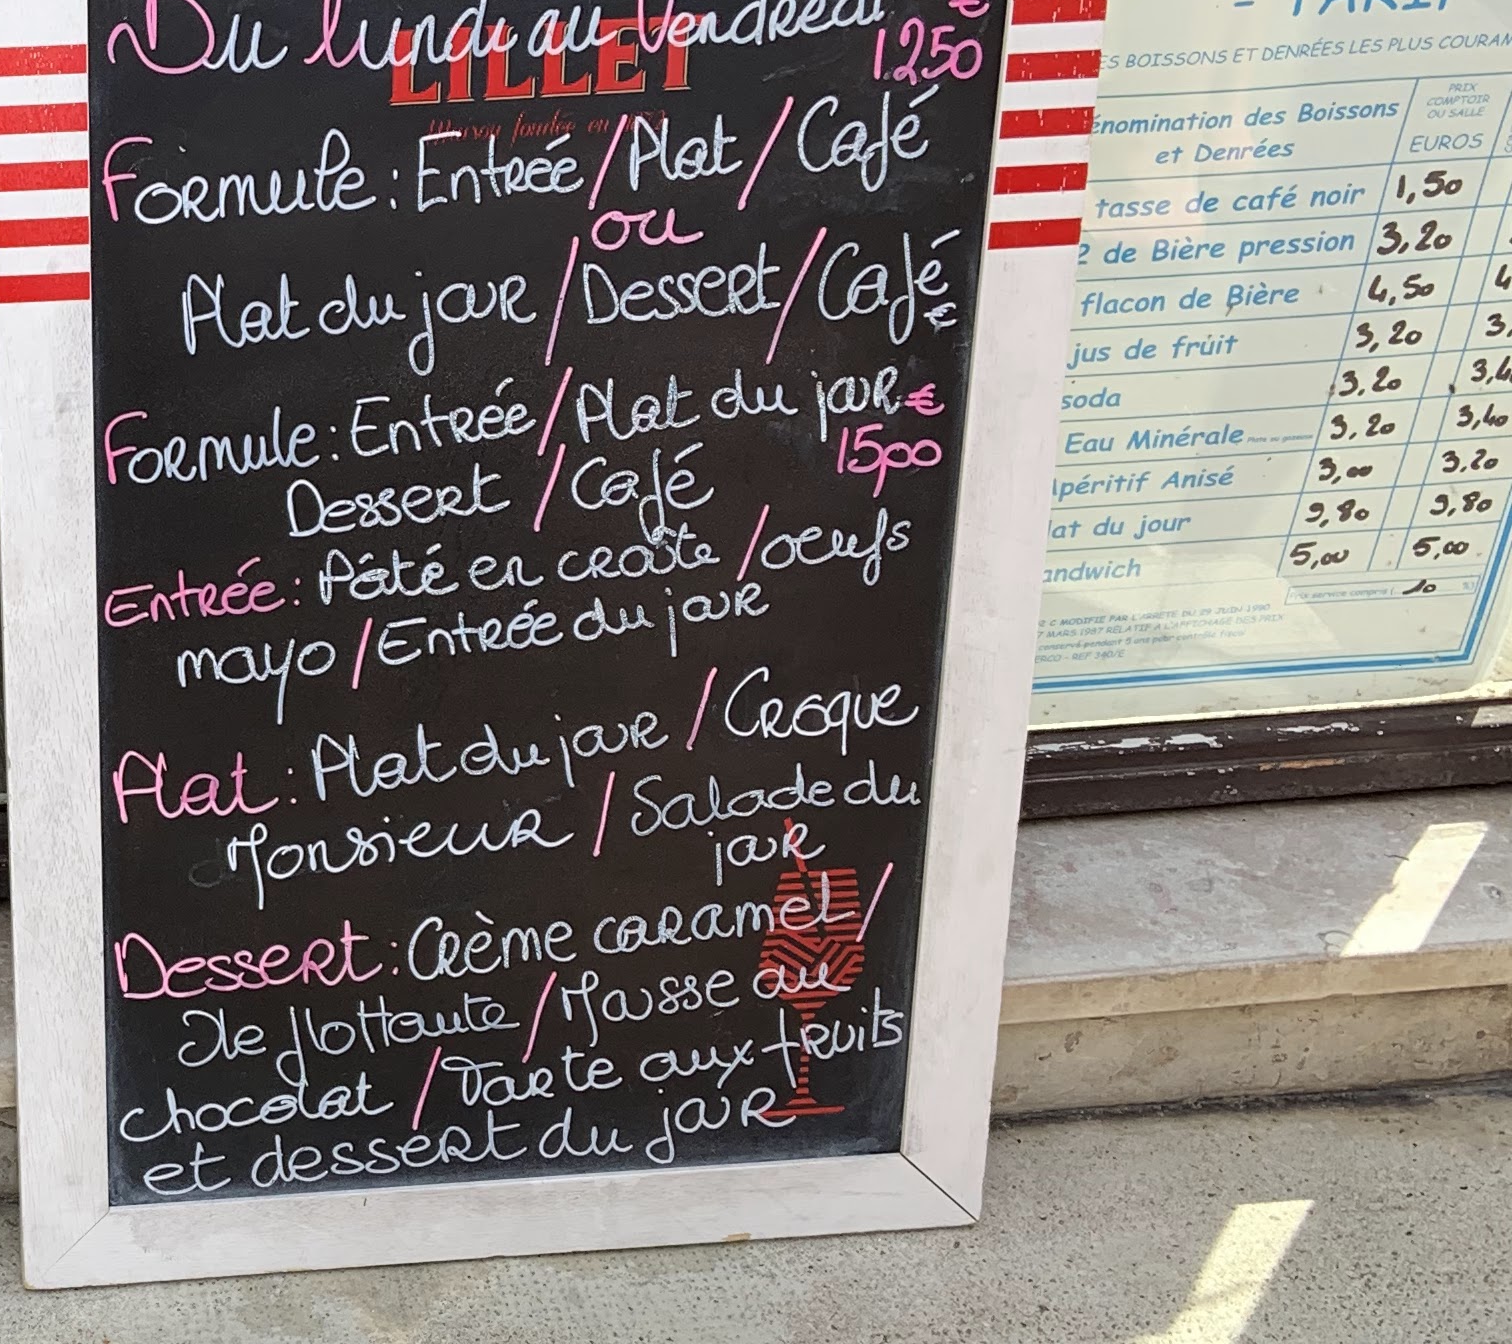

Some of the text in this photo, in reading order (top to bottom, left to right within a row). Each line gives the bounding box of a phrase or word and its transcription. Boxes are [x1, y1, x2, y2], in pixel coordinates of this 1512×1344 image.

[529, 3, 618, 57] au
[1125, 36, 1435, 70] BOISSONS ET DENRÉES LES PLUS
[1244, 82, 1479, 128] des Boissons PRIX
[1426, 94, 1491, 106] COMPTOIR
[1427, 106, 1485, 119] OU SALLE
[797, 84, 939, 193] Café
[1155, 133, 1484, 165] et Denrées EUROS
[1095, 182, 1365, 221] tasse de café noir
[1396, 169, 1463, 205] 1,50
[590, 207, 704, 252] ou
[1376, 218, 1453, 256] 3,20
[1103, 231, 1355, 265] de Bière pression
[183, 227, 962, 355] Plat du Dessert Café
[1080, 282, 1301, 317] flacon de Bière
[1367, 272, 1435, 306] 4,50
[1066, 334, 1238, 370] jus de fruit
[1355, 320, 1423, 354] 3,20
[710, 368, 800, 420] du
[1061, 386, 1122, 411] soda
[1338, 365, 1403, 398] 3,20
[1330, 412, 1396, 441] 3,20
[1455, 402, 1510, 432] 3,40
[1064, 431, 1115, 455] Eau
[1126, 423, 1245, 451] Minérale
[1160, 464, 1235, 490] Anisé
[1318, 456, 1374, 485] 3,00
[1440, 448, 1500, 474] 3,20
[285, 441, 716, 545] Dessert Café
[1428, 490, 1494, 518] 9,80
[1092, 514, 1192, 541] du jour
[1304, 498, 1371, 529] 9,80
[1412, 535, 1470, 561] 5,00
[469, 554, 546, 592] en
[176, 596, 655, 725] mayo du
[310, 666, 921, 802] Plat du Croque
[629, 759, 922, 837] Salade du
[593, 870, 858, 956] caramel
[751, 959, 854, 994] au
[118, 987, 906, 1143] chocolat Tarte aux fruits
[143, 1106, 635, 1197] et dessert du
